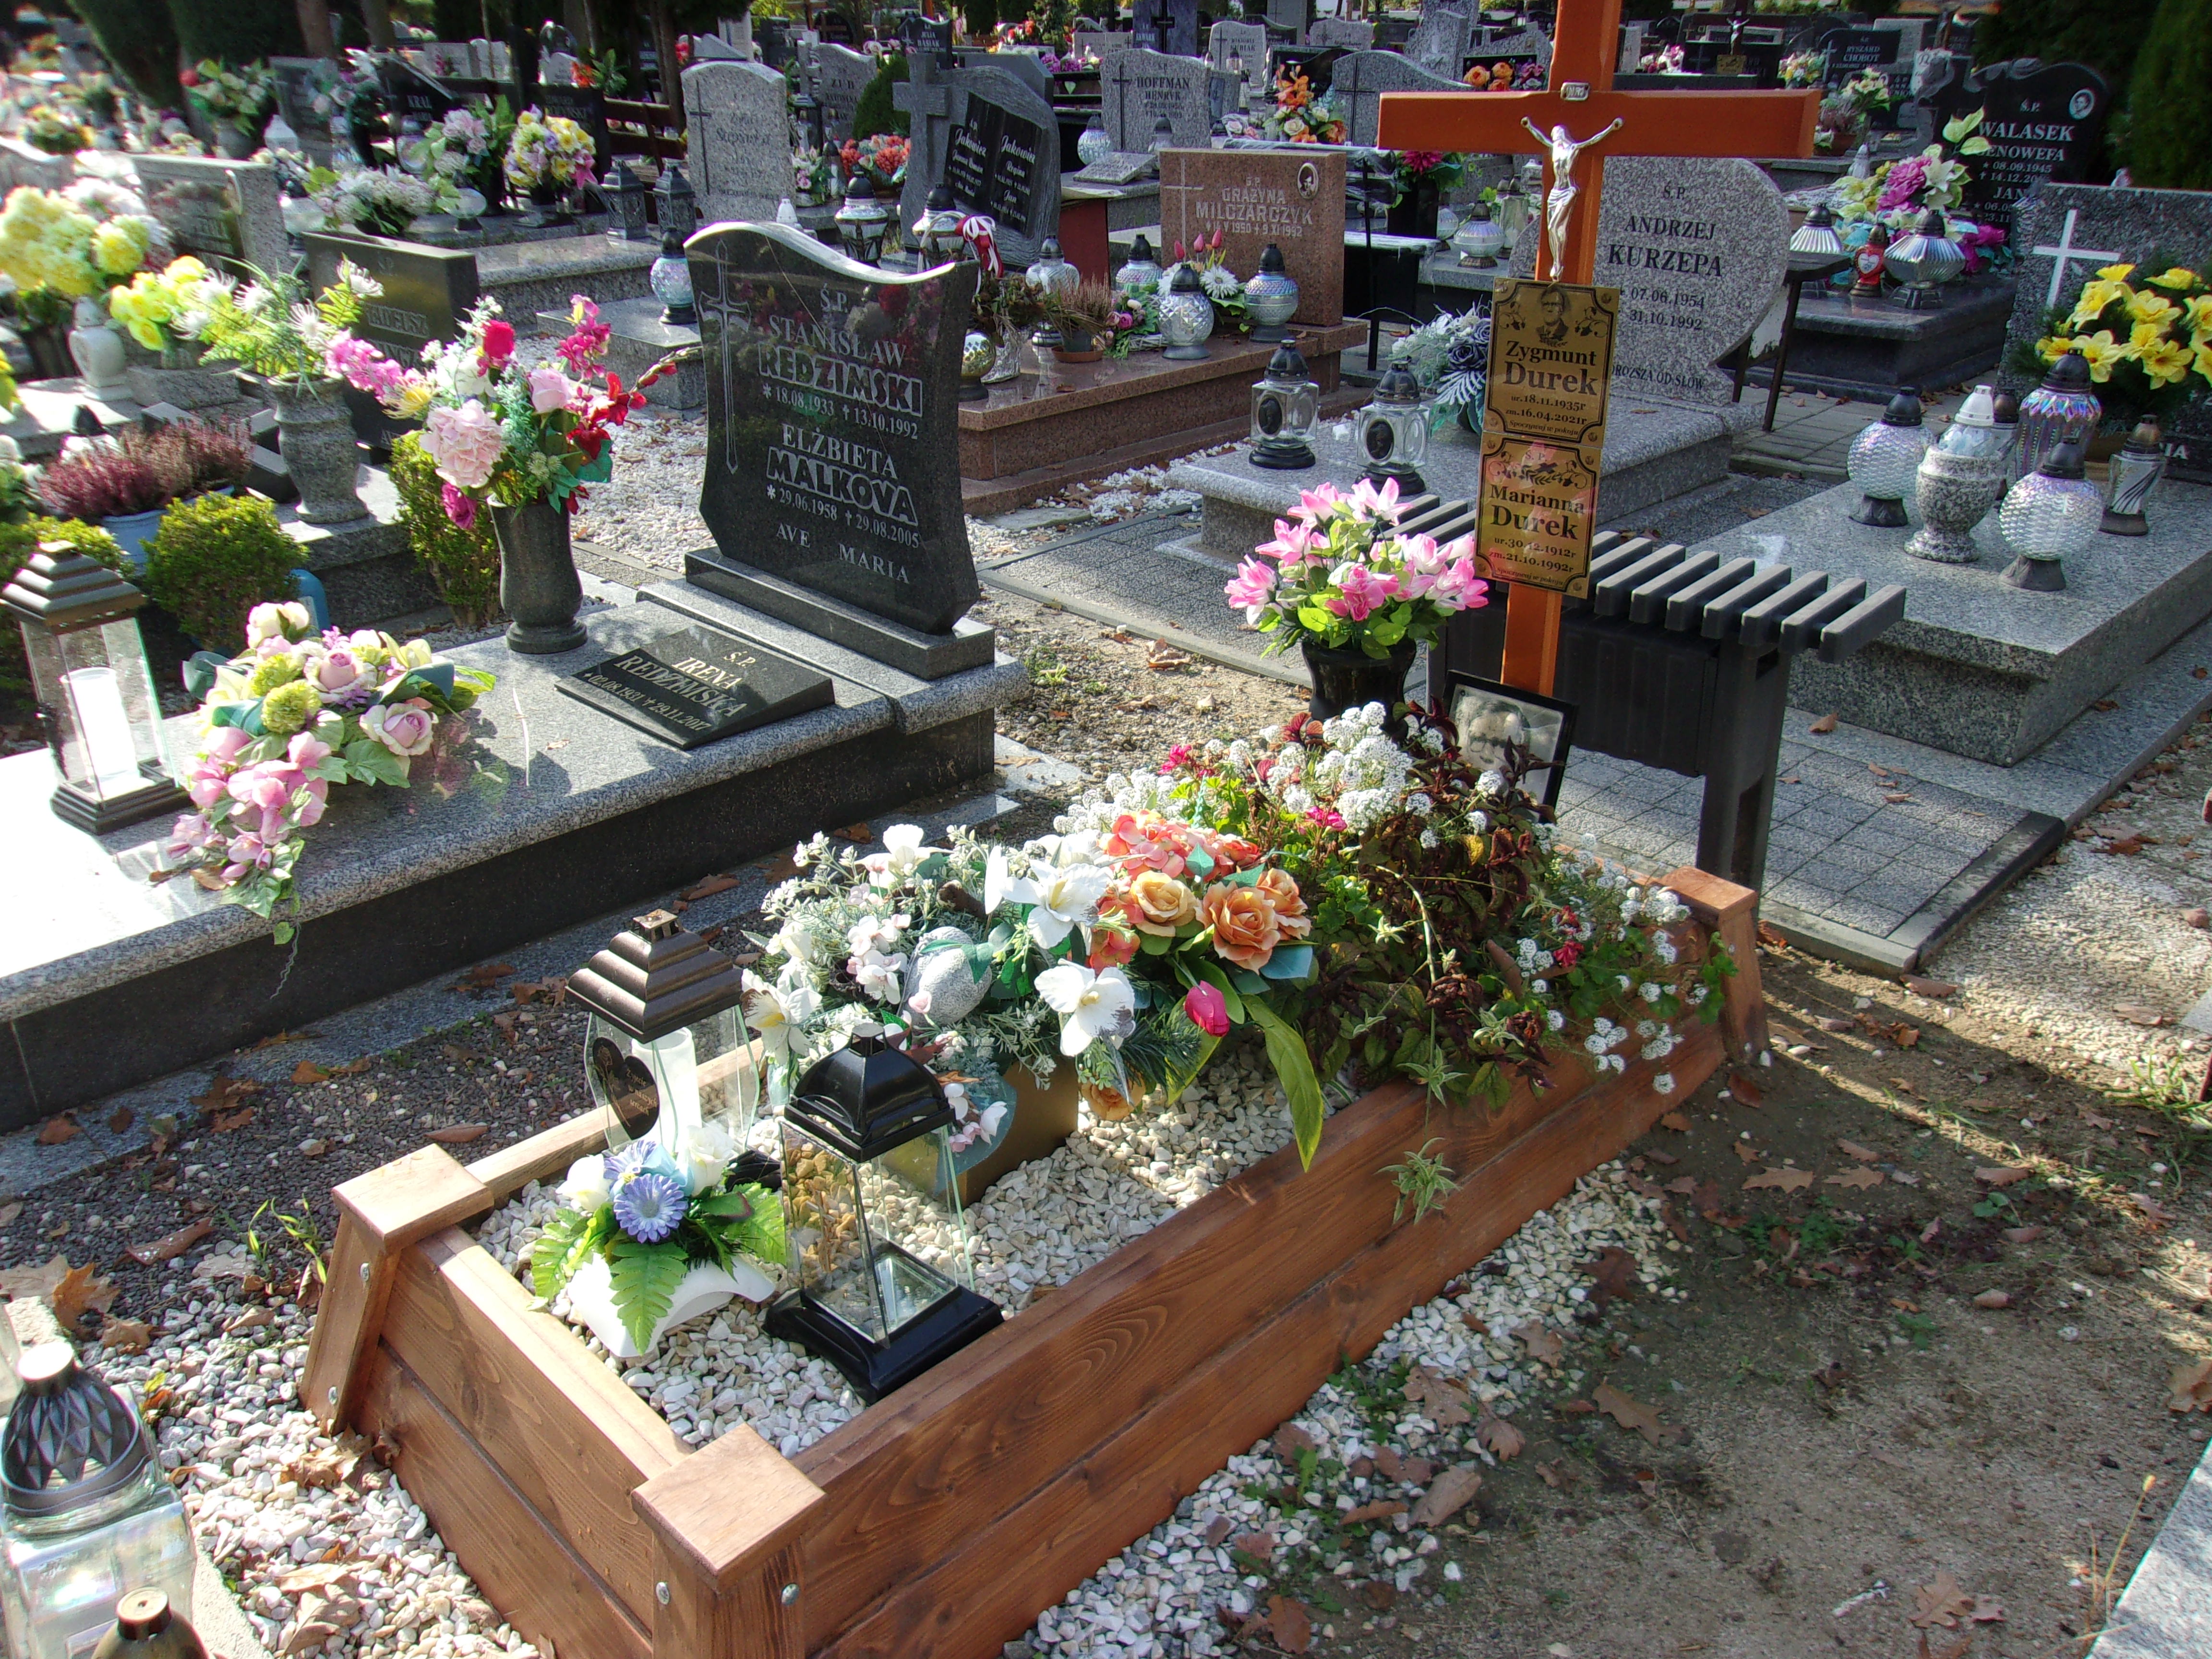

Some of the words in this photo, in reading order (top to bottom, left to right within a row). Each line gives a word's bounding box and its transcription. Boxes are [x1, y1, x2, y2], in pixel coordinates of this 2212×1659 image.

[1137, 76, 1190, 89] HOFFMAN
[1978, 120, 2076, 142] WALASEK
[1993, 161, 2052, 173] 08.09.1945
[1196, 201, 1312, 225] MILCZARCZYK
[1624, 215, 1716, 240] ANDRZEJ
[1608, 244, 1722, 277] KURZEPA
[1631, 288, 1704, 309] 07.06.1954
[1629, 310, 1702, 330] 31.10.1992
[769, 315, 906, 368] STANISŁAW
[1505, 340, 1597, 366] Zygmunt
[1503, 361, 1598, 396] Durek
[1657, 371, 1671, 385] OD
[775, 385, 834, 416] 18.08.1933
[854, 408, 918, 440] 13.10.1992
[1510, 420, 1546, 431] Spoczywaj
[1554, 426, 1578, 435] pokoju
[781, 423, 898, 480] ELŻBIETA
[766, 446, 919, 527] MALKOVA
[1490, 483, 1585, 515] Marianna
[779, 488, 837, 521] 29.06.1958
[856, 514, 920, 548] 29.08.2005
[1491, 504, 1578, 540] Durek
[776, 522, 811, 549] AVE
[839, 543, 910, 584] MARIA
[672, 657, 743, 690] IRENA
[588, 674, 646, 702] 02.08.1931
[648, 702, 711, 731] 29.11.2017
